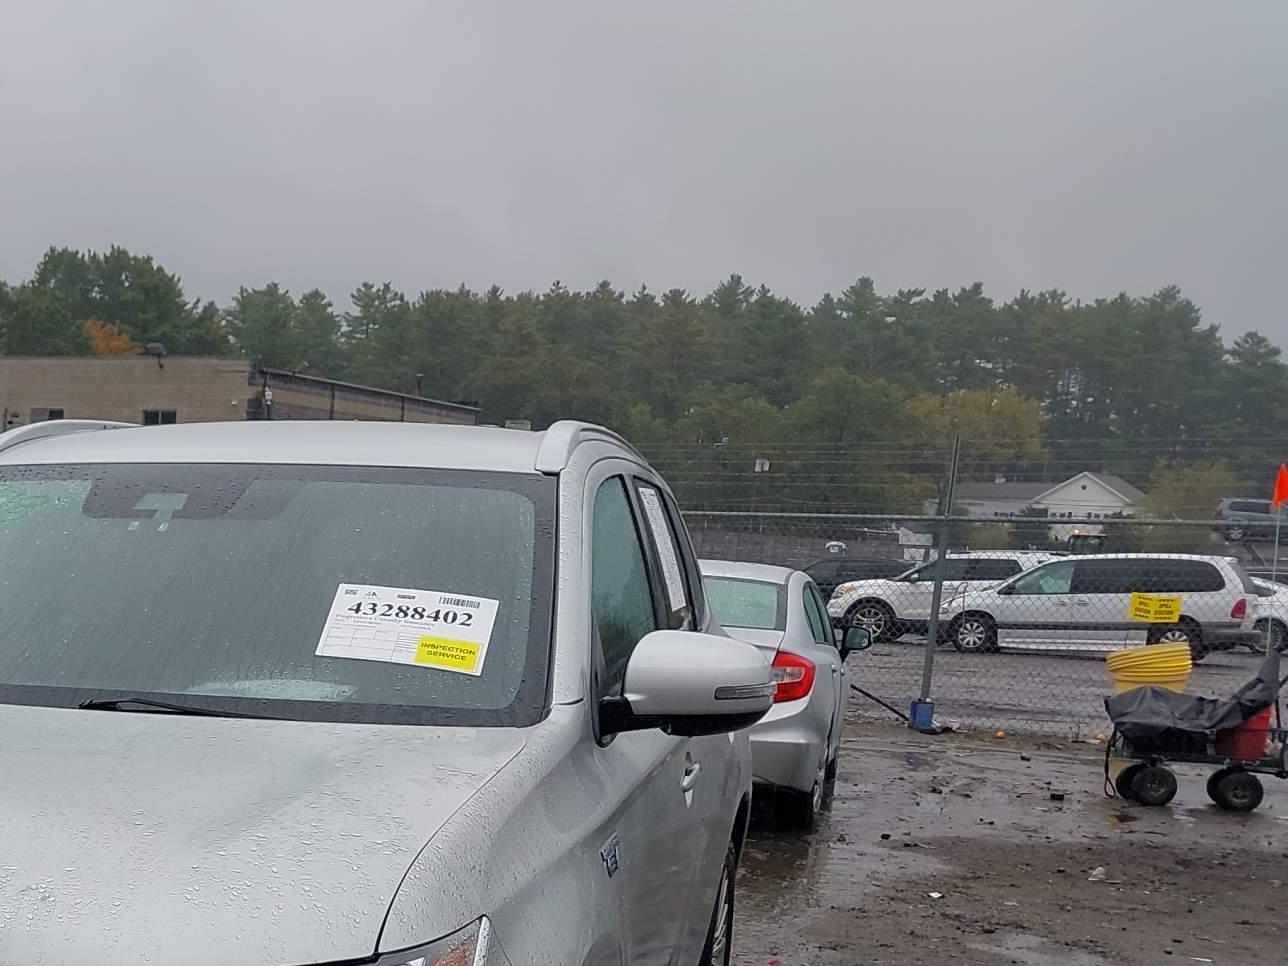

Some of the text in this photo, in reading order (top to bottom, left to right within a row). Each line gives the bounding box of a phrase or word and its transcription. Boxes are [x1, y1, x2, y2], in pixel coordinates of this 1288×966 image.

[348, 601, 473, 627] 43288402
[420, 642, 476, 656] INSPECTION
[426, 650, 467, 661] SERVICE
